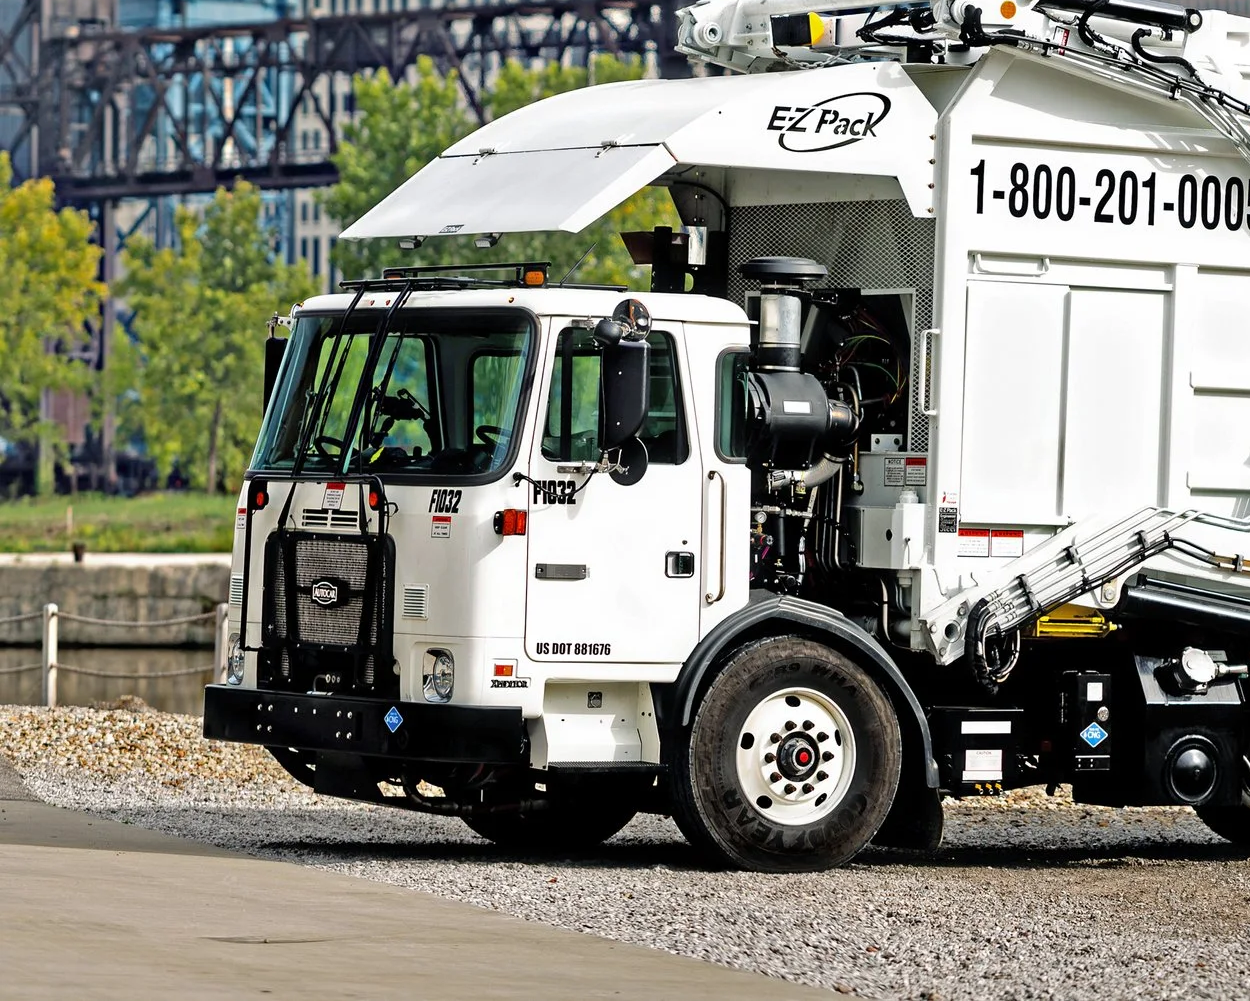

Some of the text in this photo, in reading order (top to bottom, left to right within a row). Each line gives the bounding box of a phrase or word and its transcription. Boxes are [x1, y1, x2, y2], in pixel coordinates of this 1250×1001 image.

[815, 108, 877, 137] Pack
[315, 588, 335, 598] AUTOCAR
[536, 642, 611, 656] US DOT 881676
[1088, 731, 1100, 739] CNG
